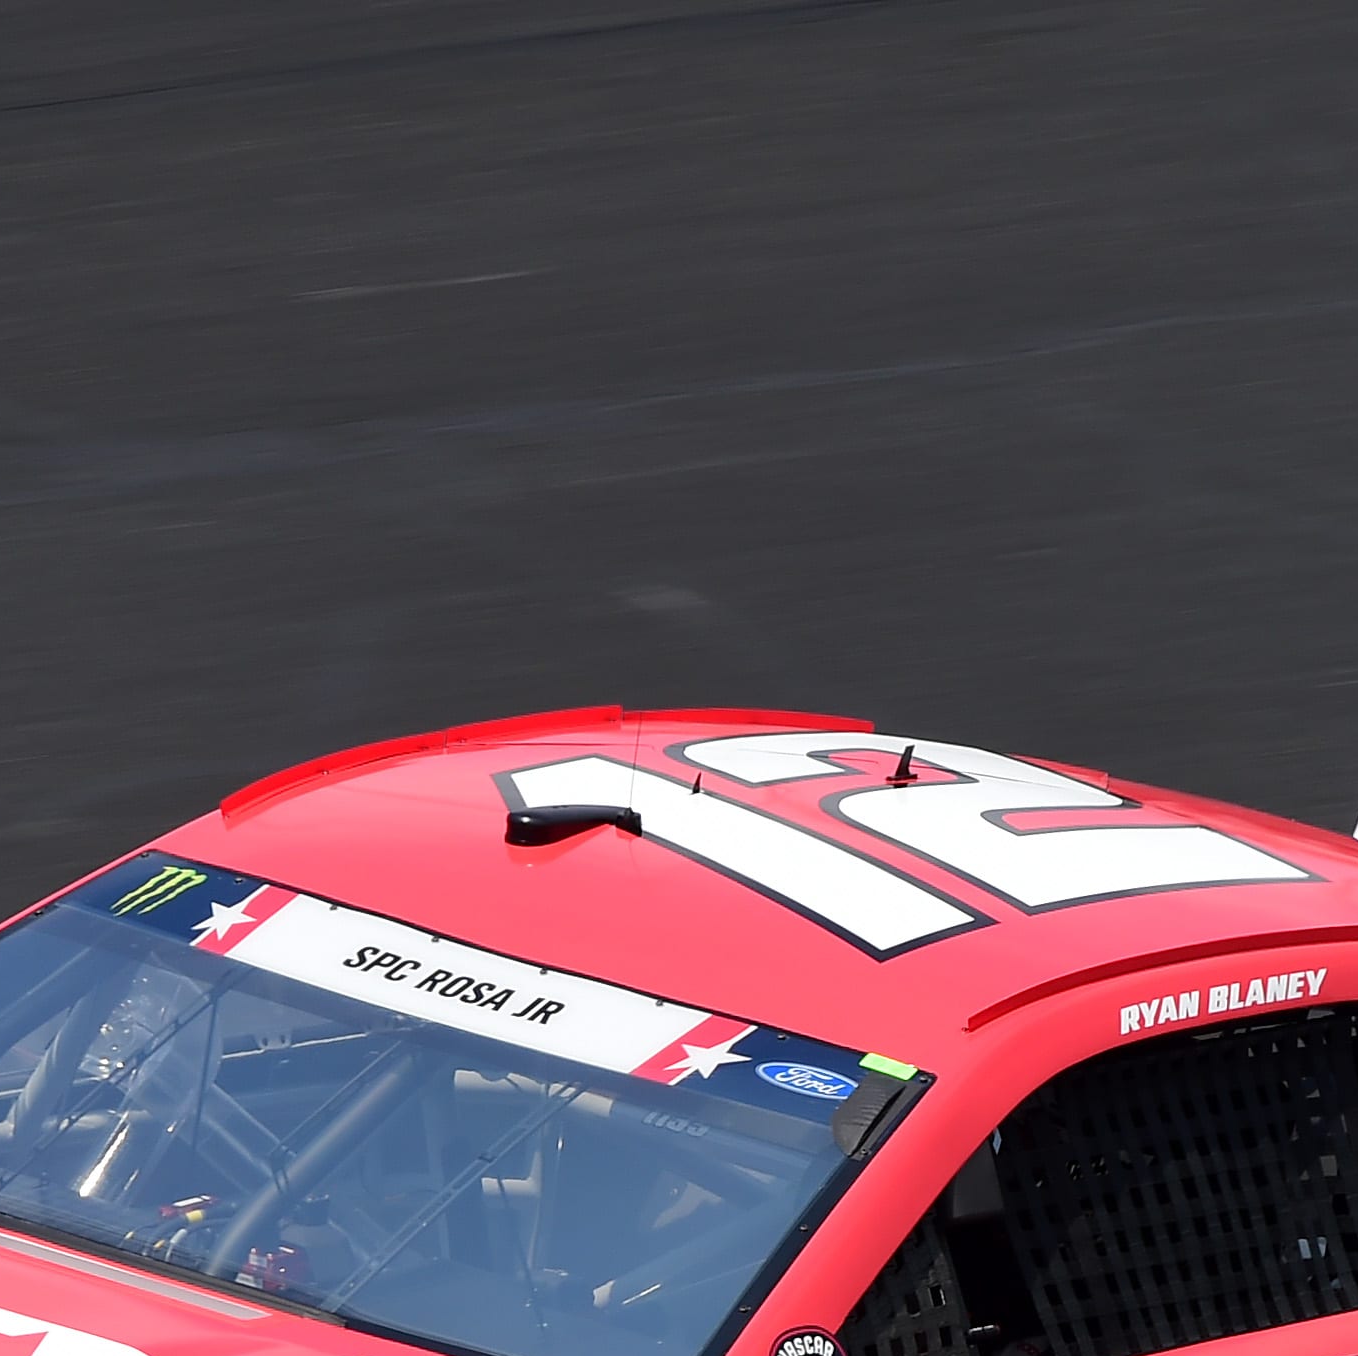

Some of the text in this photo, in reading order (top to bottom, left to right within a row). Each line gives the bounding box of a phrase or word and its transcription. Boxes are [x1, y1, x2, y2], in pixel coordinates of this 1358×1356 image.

[494, 730, 1326, 960] 12
[343, 945, 564, 1027] SPC ROSA JR
[1119, 967, 1328, 1036] RYAN BLANEY
[774, 1066, 845, 1095] Ford
